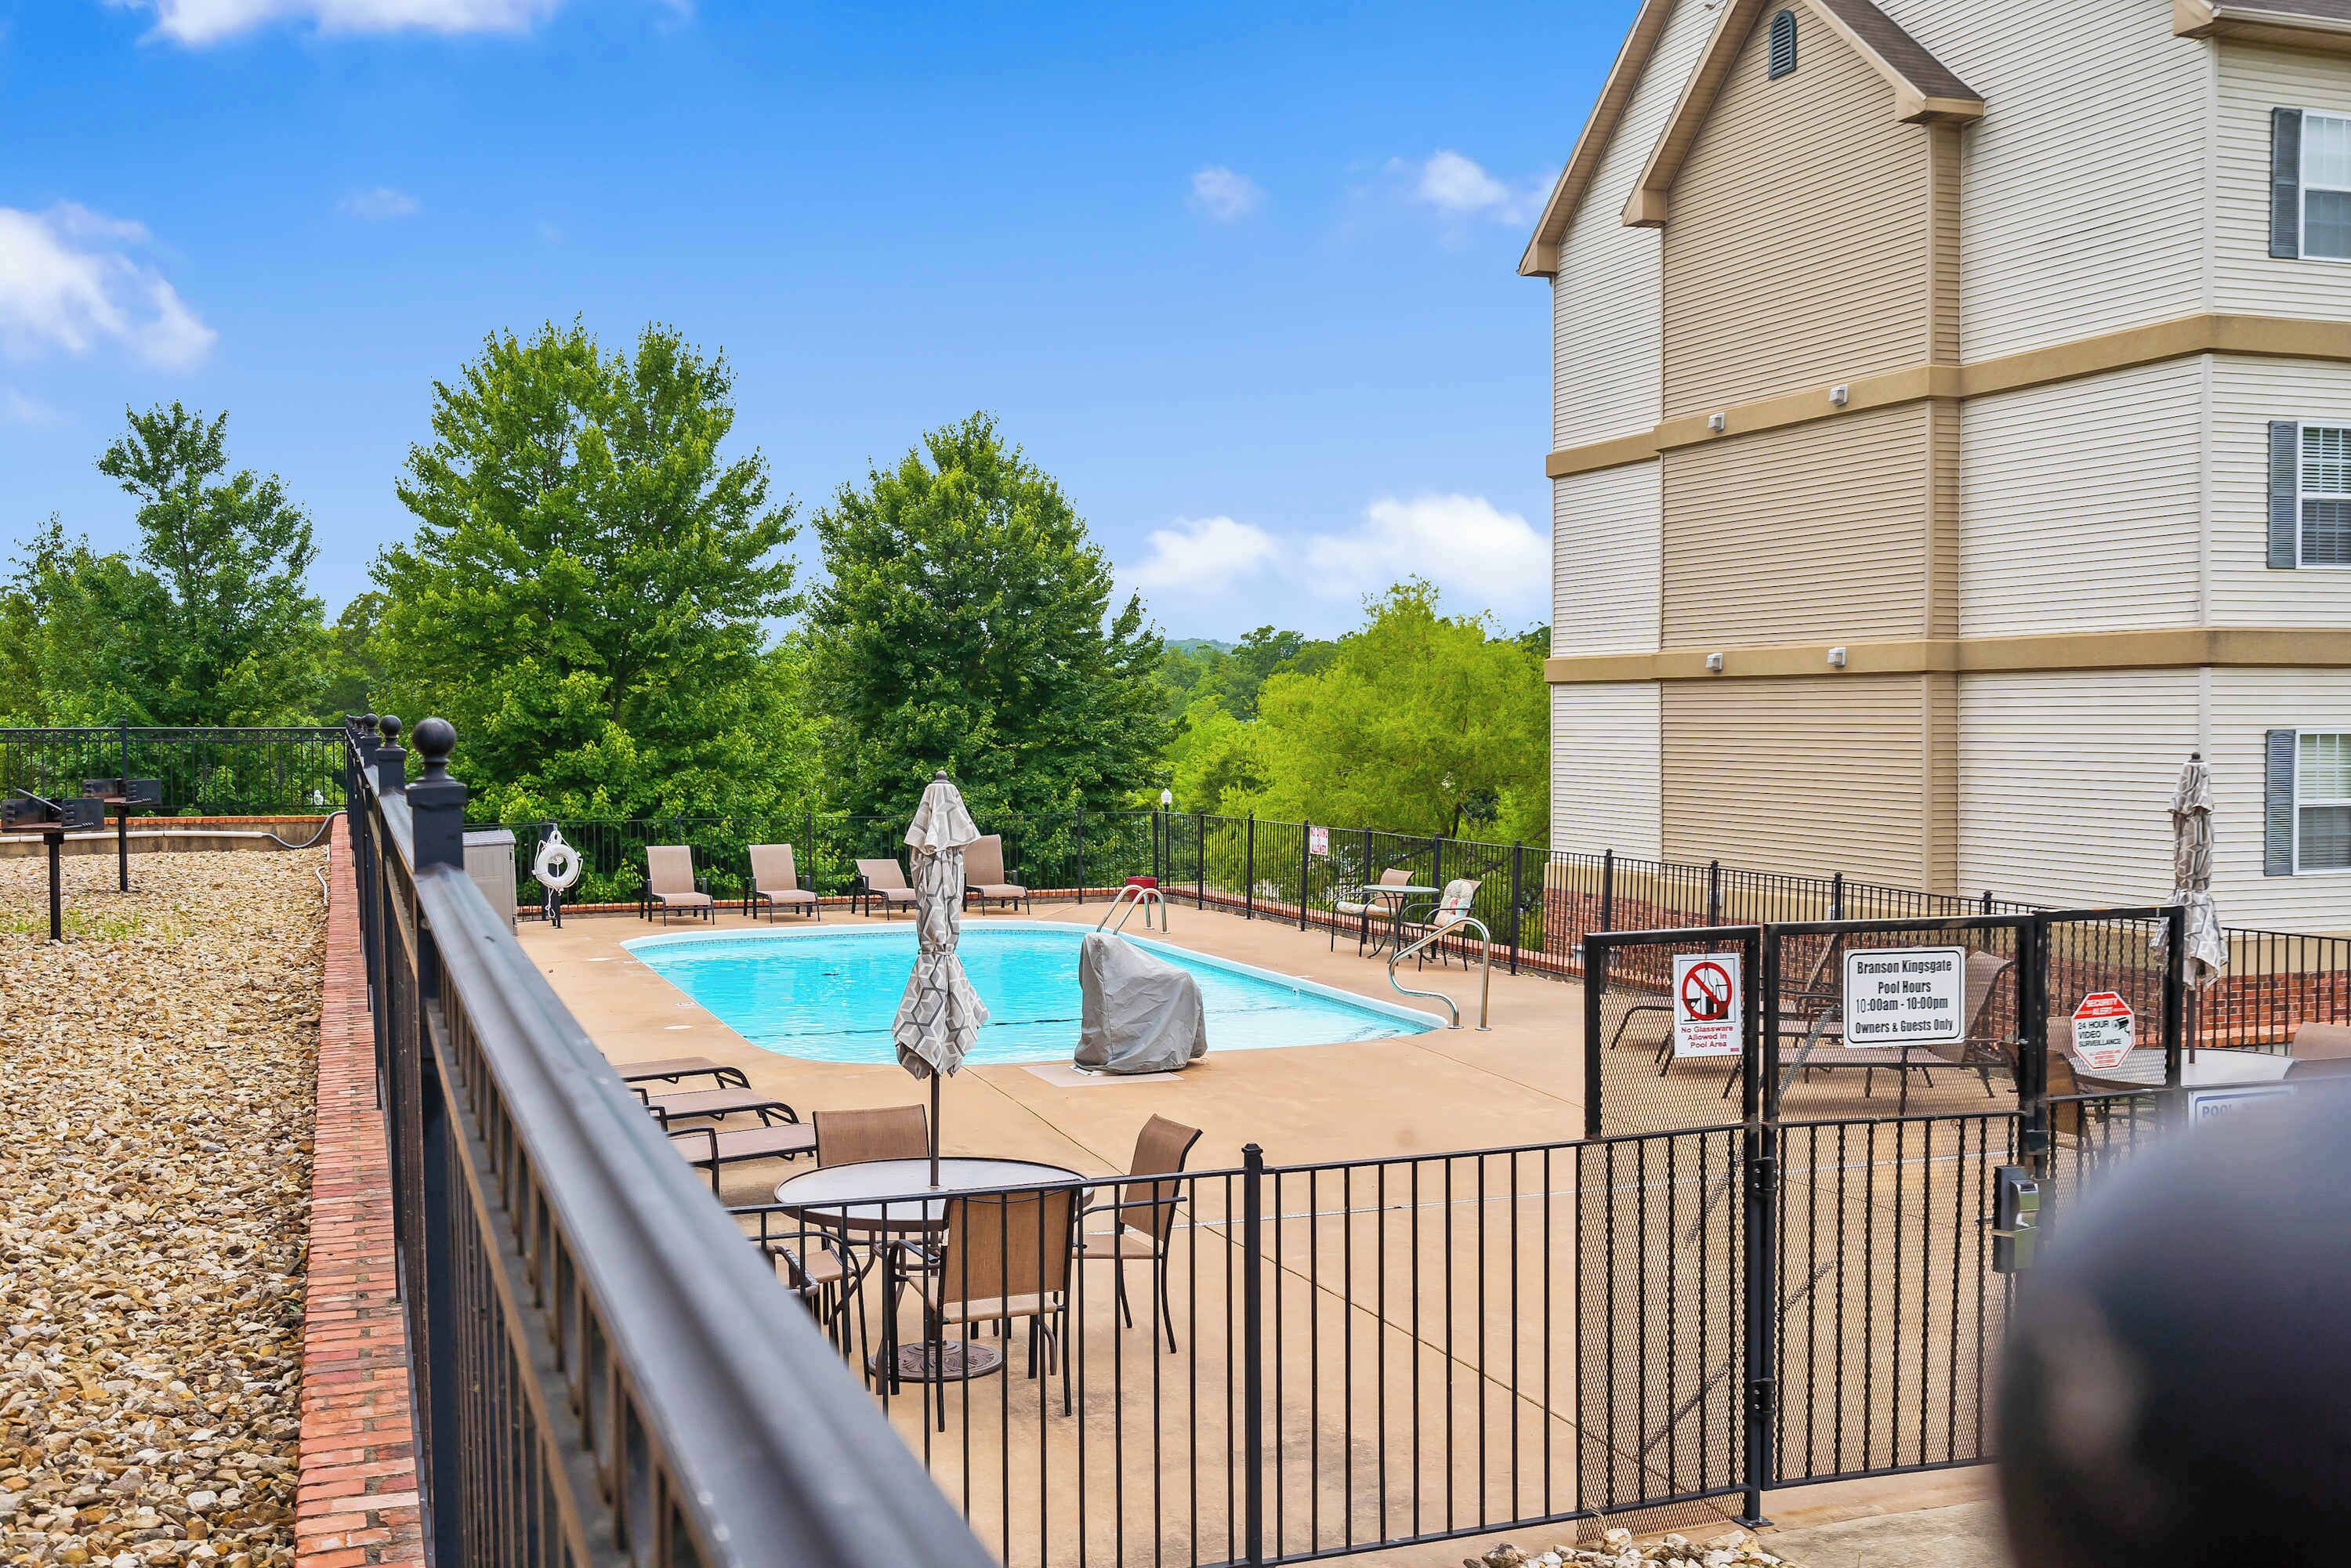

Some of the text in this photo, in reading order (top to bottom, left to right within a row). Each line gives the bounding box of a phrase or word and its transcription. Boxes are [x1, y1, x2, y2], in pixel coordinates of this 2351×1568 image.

[1857, 960, 1952, 974] Branson Kingsgate
[1878, 980, 1932, 994] Pool Hours
[1856, 998, 1898, 1013] 10:00am
[1907, 997, 1948, 1010] 10:00pm
[1856, 1019, 1953, 1034] Owners & Guests Only
[2078, 1038, 2121, 1047] SURVEILLANCE
